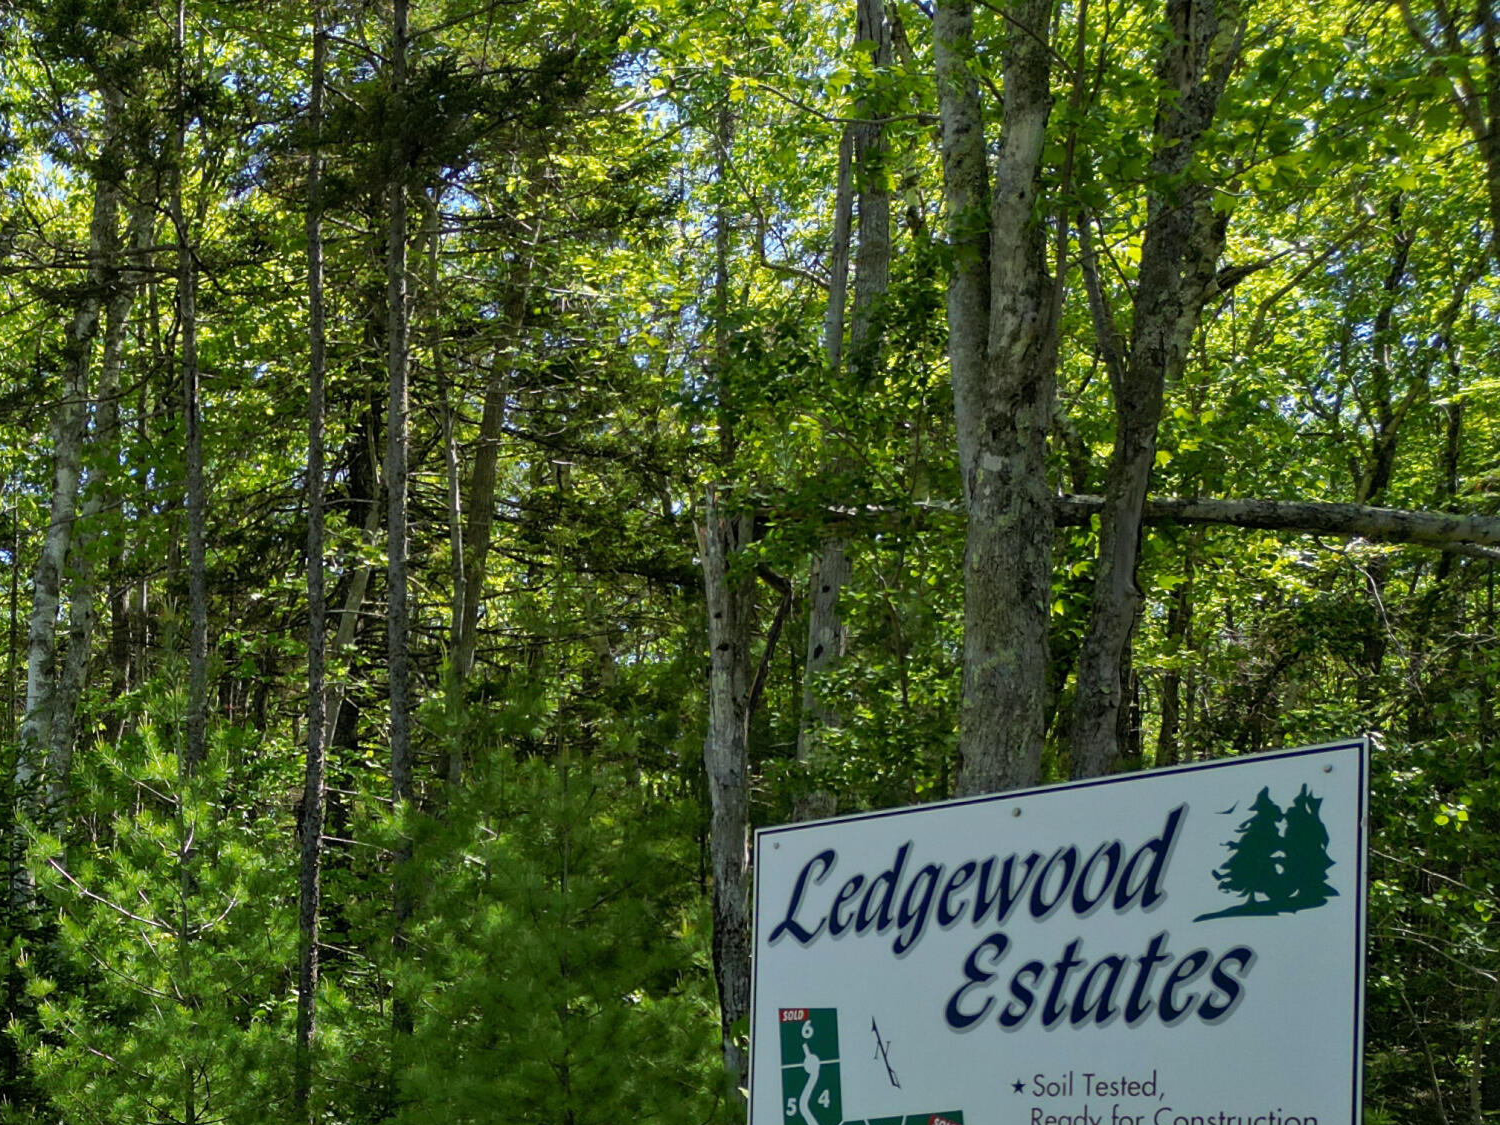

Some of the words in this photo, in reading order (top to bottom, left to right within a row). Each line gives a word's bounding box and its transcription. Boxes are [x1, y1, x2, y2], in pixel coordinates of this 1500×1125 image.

[768, 803, 1189, 959] Ledgewood
[945, 931, 1257, 1034] Estates
[782, 1009, 804, 1021] SOLD
[801, 1020, 814, 1039] 6
[1032, 1071, 1073, 1097] Soil
[1082, 1069, 1165, 1101] Tested,
[786, 1098, 797, 1116] 5
[818, 1089, 831, 1108] 4
